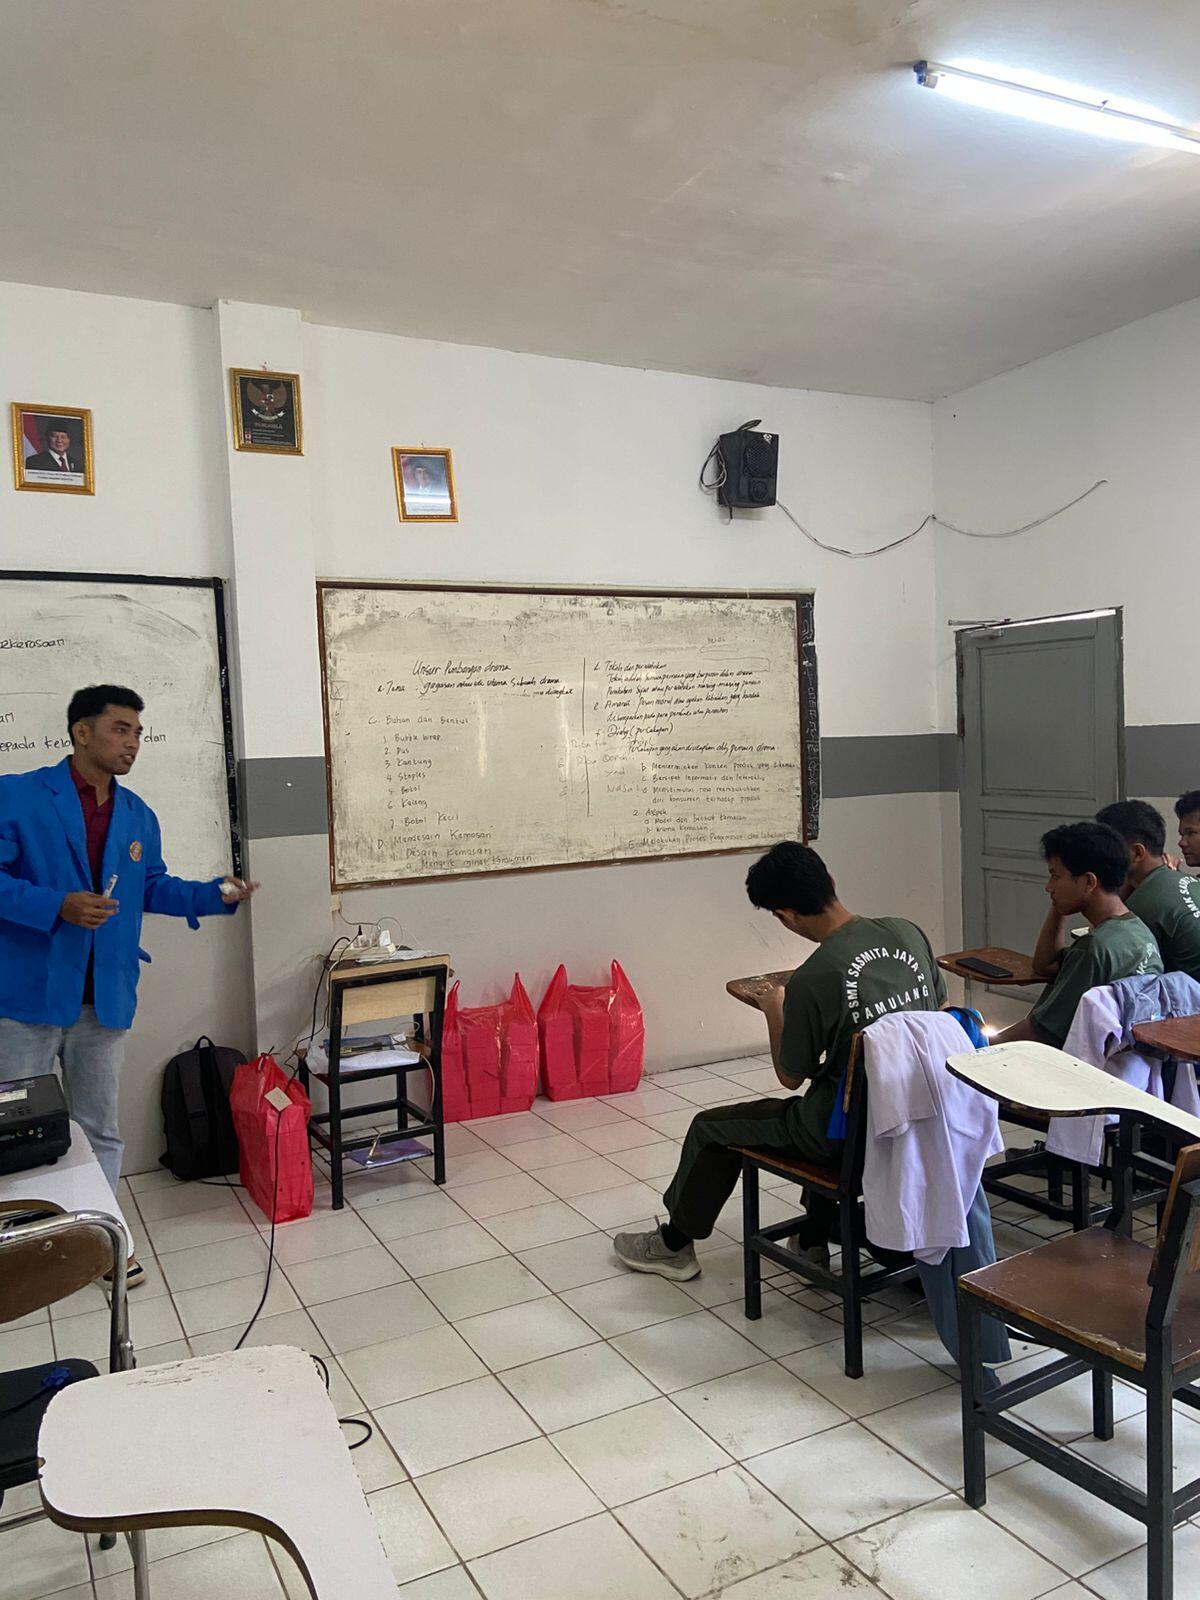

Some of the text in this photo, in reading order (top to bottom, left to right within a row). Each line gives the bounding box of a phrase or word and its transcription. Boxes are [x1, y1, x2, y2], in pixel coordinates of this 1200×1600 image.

[417, 715, 433, 723] dan
[143, 727, 167, 743] dan
[846, 947, 925, 1009] SMK SASMITA JAYA 2
[852, 985, 930, 1024] PAMULANG
